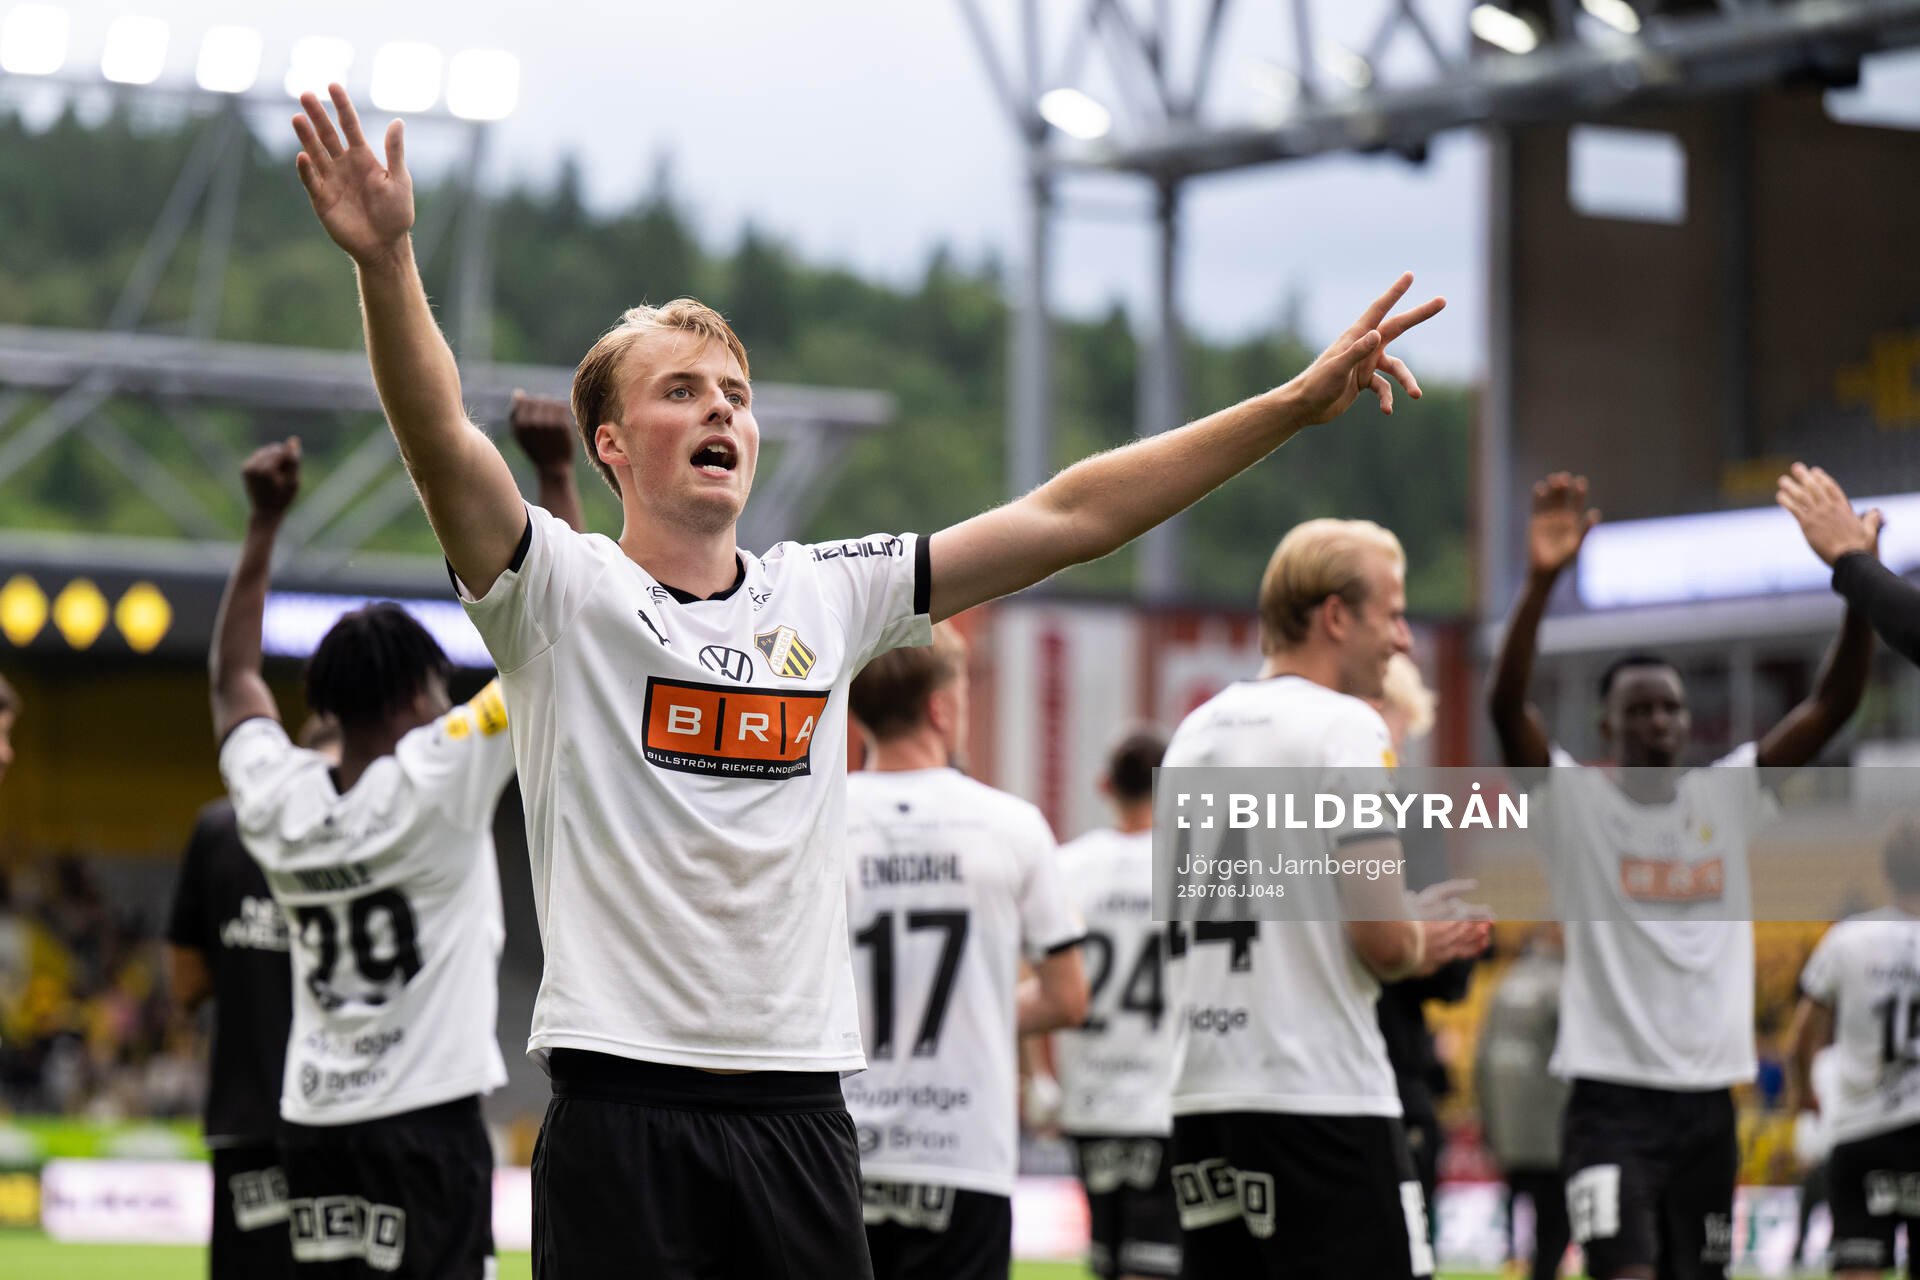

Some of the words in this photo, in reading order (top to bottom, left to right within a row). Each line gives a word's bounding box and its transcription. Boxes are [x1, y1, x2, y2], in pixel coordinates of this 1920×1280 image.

[647, 751, 717, 770] BILLSTRÖM
[721, 763, 764, 773] RIEMER
[855, 910, 970, 1060] 17
